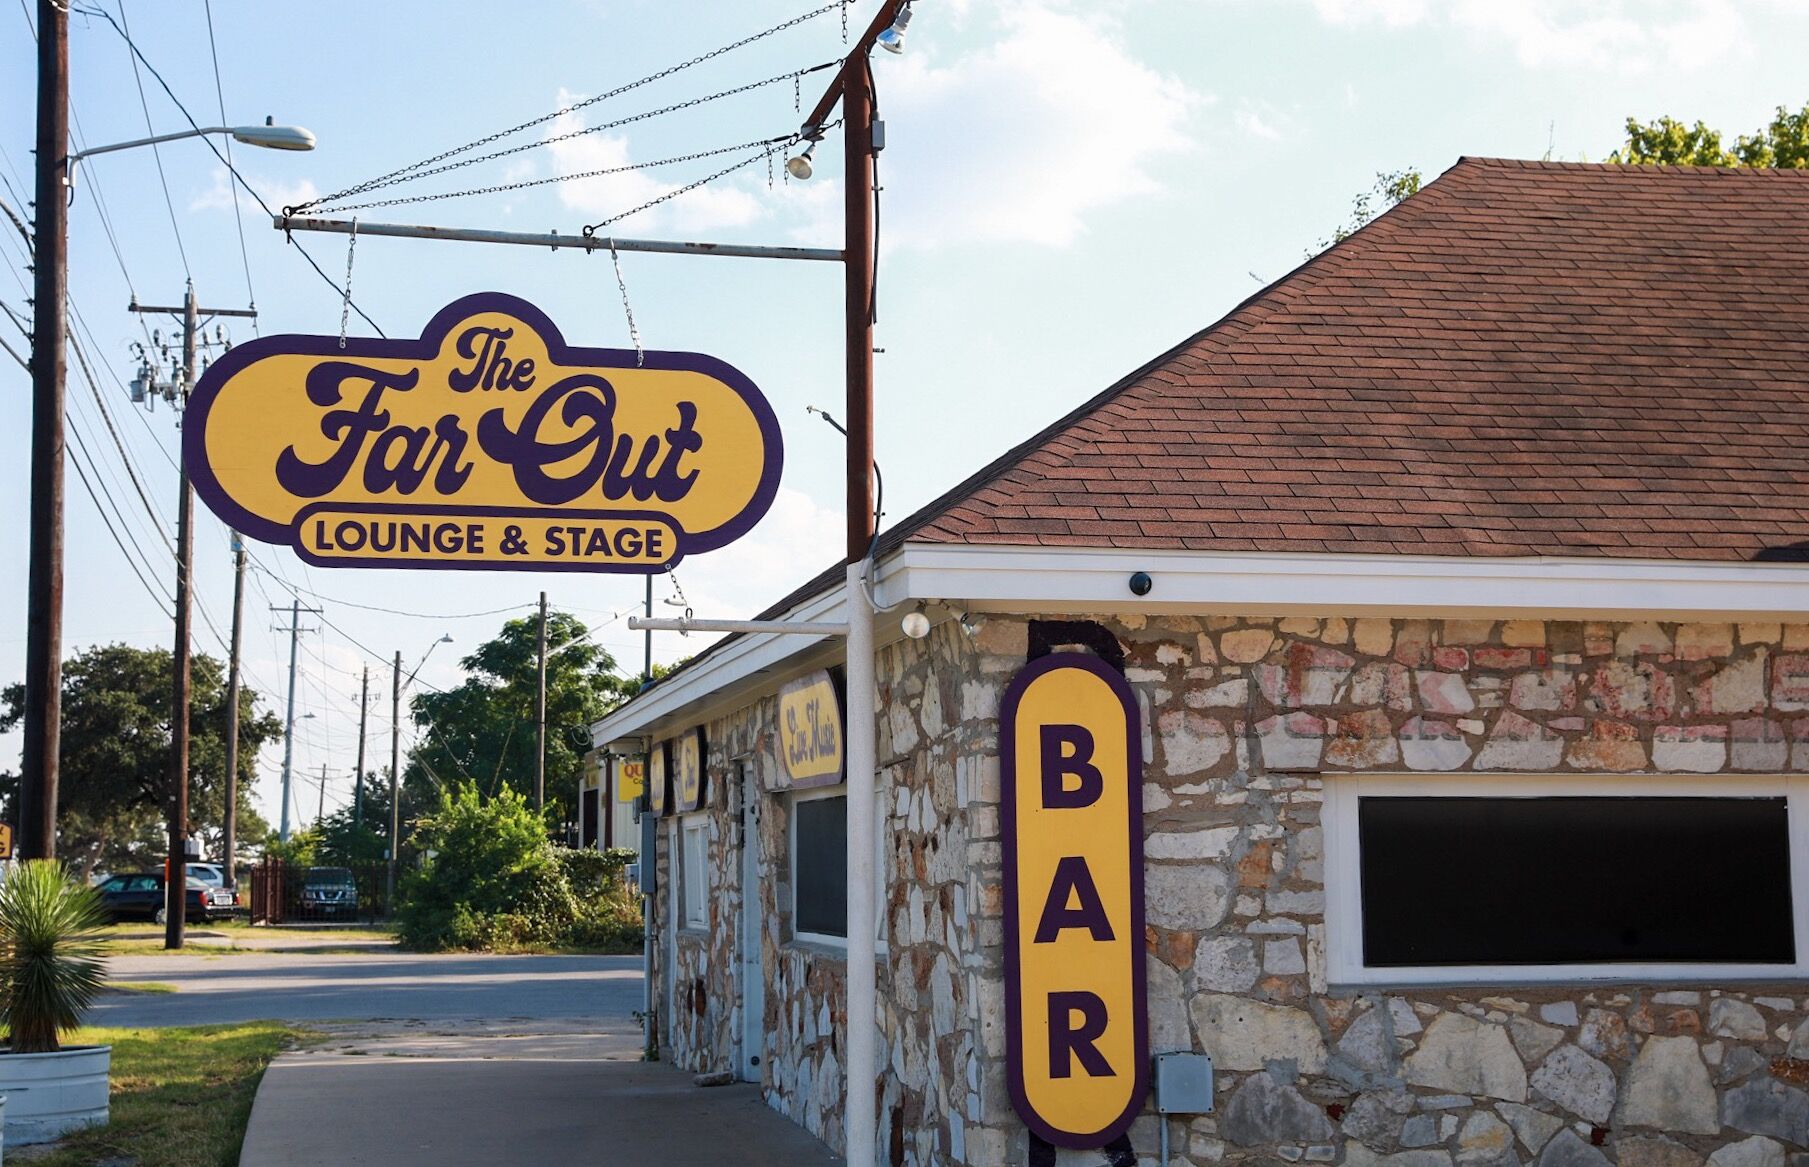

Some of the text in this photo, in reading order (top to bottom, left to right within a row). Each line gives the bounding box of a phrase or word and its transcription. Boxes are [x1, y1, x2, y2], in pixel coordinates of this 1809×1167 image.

[448, 326, 537, 393] The
[276, 360, 704, 506] Far Out
[315, 520, 664, 558] LOUNGE & STAGE
[787, 698, 836, 767] Live Music
[1034, 723, 1117, 1080] BAR
